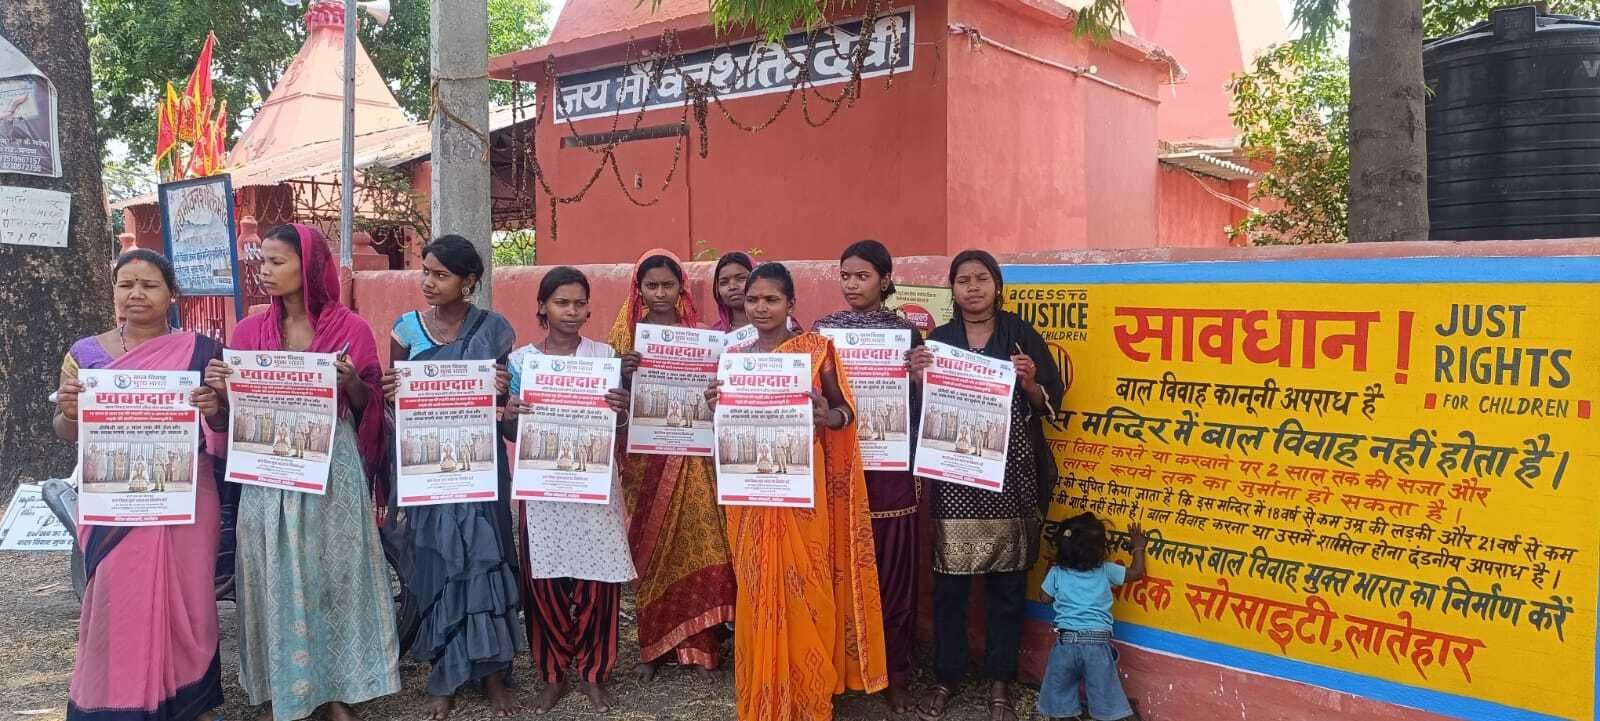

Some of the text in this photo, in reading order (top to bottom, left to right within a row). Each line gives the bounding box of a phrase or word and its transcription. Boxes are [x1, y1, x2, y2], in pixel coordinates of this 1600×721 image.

[557, 79, 611, 116] जय
[1435, 304, 1526, 338] JUST
[1434, 345, 1572, 388] RIGHTS
[1116, 371, 1385, 421] बाल विवाह कानूनी अपराध है
[1443, 393, 1569, 418] FOR CHILDREN
[1045, 411, 1077, 432] स
[1082, 406, 1172, 444] मन्दिर
[1173, 409, 1200, 446] में
[1201, 422, 1270, 456] बाल
[1272, 418, 1368, 468] विवाह
[1369, 428, 1437, 475] नहीं
[1436, 430, 1519, 478] होता
[1072, 437, 1109, 457] विवाह
[1111, 444, 1148, 461] करने
[1152, 450, 1172, 464] या
[1175, 454, 1234, 471] करवाने
[1238, 460, 1263, 478] पर
[1267, 463, 1279, 477] 2
[1285, 465, 1329, 487] साल
[1331, 470, 1360, 488] तक
[1364, 469, 1392, 490] की
[1448, 477, 1491, 508] और
[1162, 471, 1197, 486] तक
[1202, 475, 1232, 491] का
[1305, 486, 1334, 505] हो
[1340, 493, 1418, 518] सकता
[1107, 480, 1133, 498] किया
[1135, 487, 1163, 501] जाता
[1163, 487, 1175, 505] है
[1178, 490, 1195, 507] कि
[1196, 496, 1216, 511] इस
[1254, 500, 1266, 518] में
[1302, 507, 1317, 527] से
[1317, 514, 1343, 528] कम
[1368, 516, 1389, 536] की
[1438, 525, 1477, 549] और
[1523, 537, 1542, 562] से
[1543, 546, 1578, 563] कम
[1107, 498, 1130, 516] होती
[1147, 508, 1173, 524] बाल
[1175, 508, 1210, 531] विवाह
[1212, 517, 1249, 535] करना
[1252, 524, 1275, 540] या
[1316, 532, 1371, 556] शामिल
[1371, 539, 1406, 560] होना
[1466, 557, 1529, 580] अपराध
[1145, 529, 1209, 572] मिलकर
[1207, 547, 1247, 576] बाल
[1249, 545, 1304, 593] विवाह
[1353, 572, 1411, 608] भारत
[1410, 580, 1440, 611] का
[1441, 576, 1527, 626] निर्माण
[1528, 595, 1574, 643] करें
